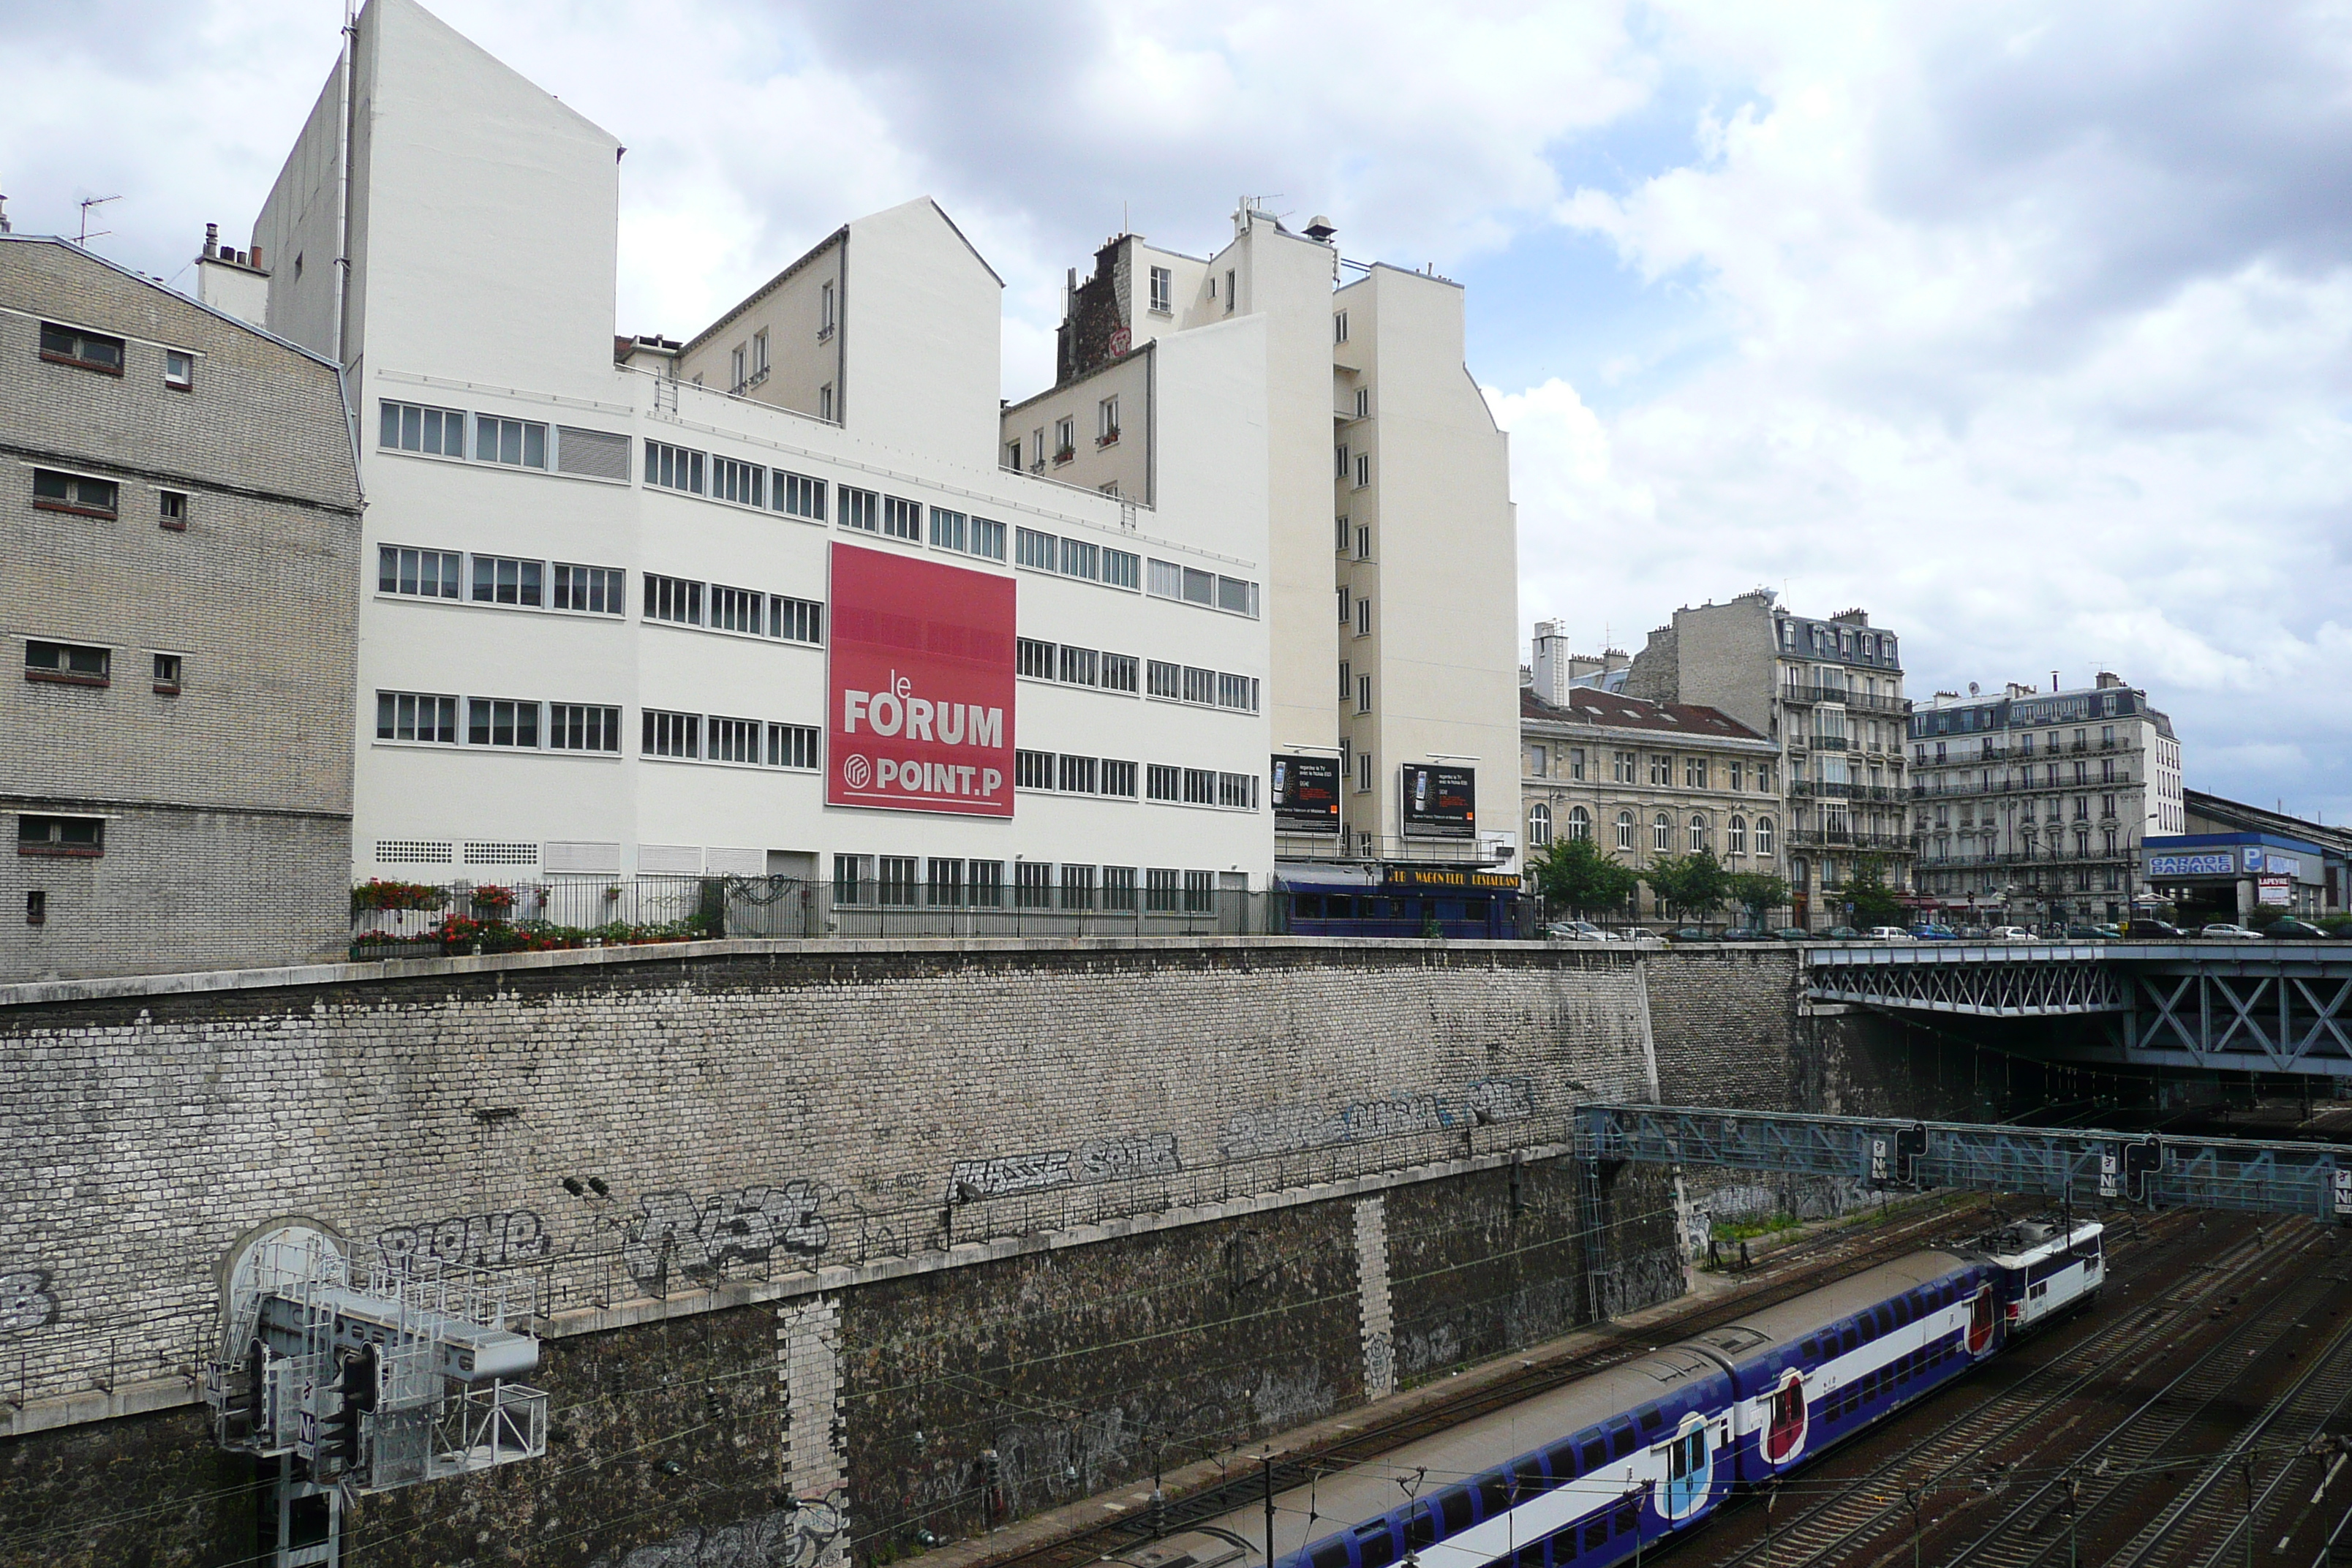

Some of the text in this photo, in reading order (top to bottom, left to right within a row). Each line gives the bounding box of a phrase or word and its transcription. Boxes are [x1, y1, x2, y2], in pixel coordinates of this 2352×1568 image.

[891, 668, 911, 699] le
[844, 688, 1003, 748] FORUM
[877, 758, 1002, 797] POINT.P
[2151, 856, 2230, 867] GARAGE
[2244, 848, 2260, 864] P
[2152, 864, 2231, 874] PARKING
[1415, 871, 1444, 884] WAGON
[1471, 874, 1518, 887] RESTAURANT
